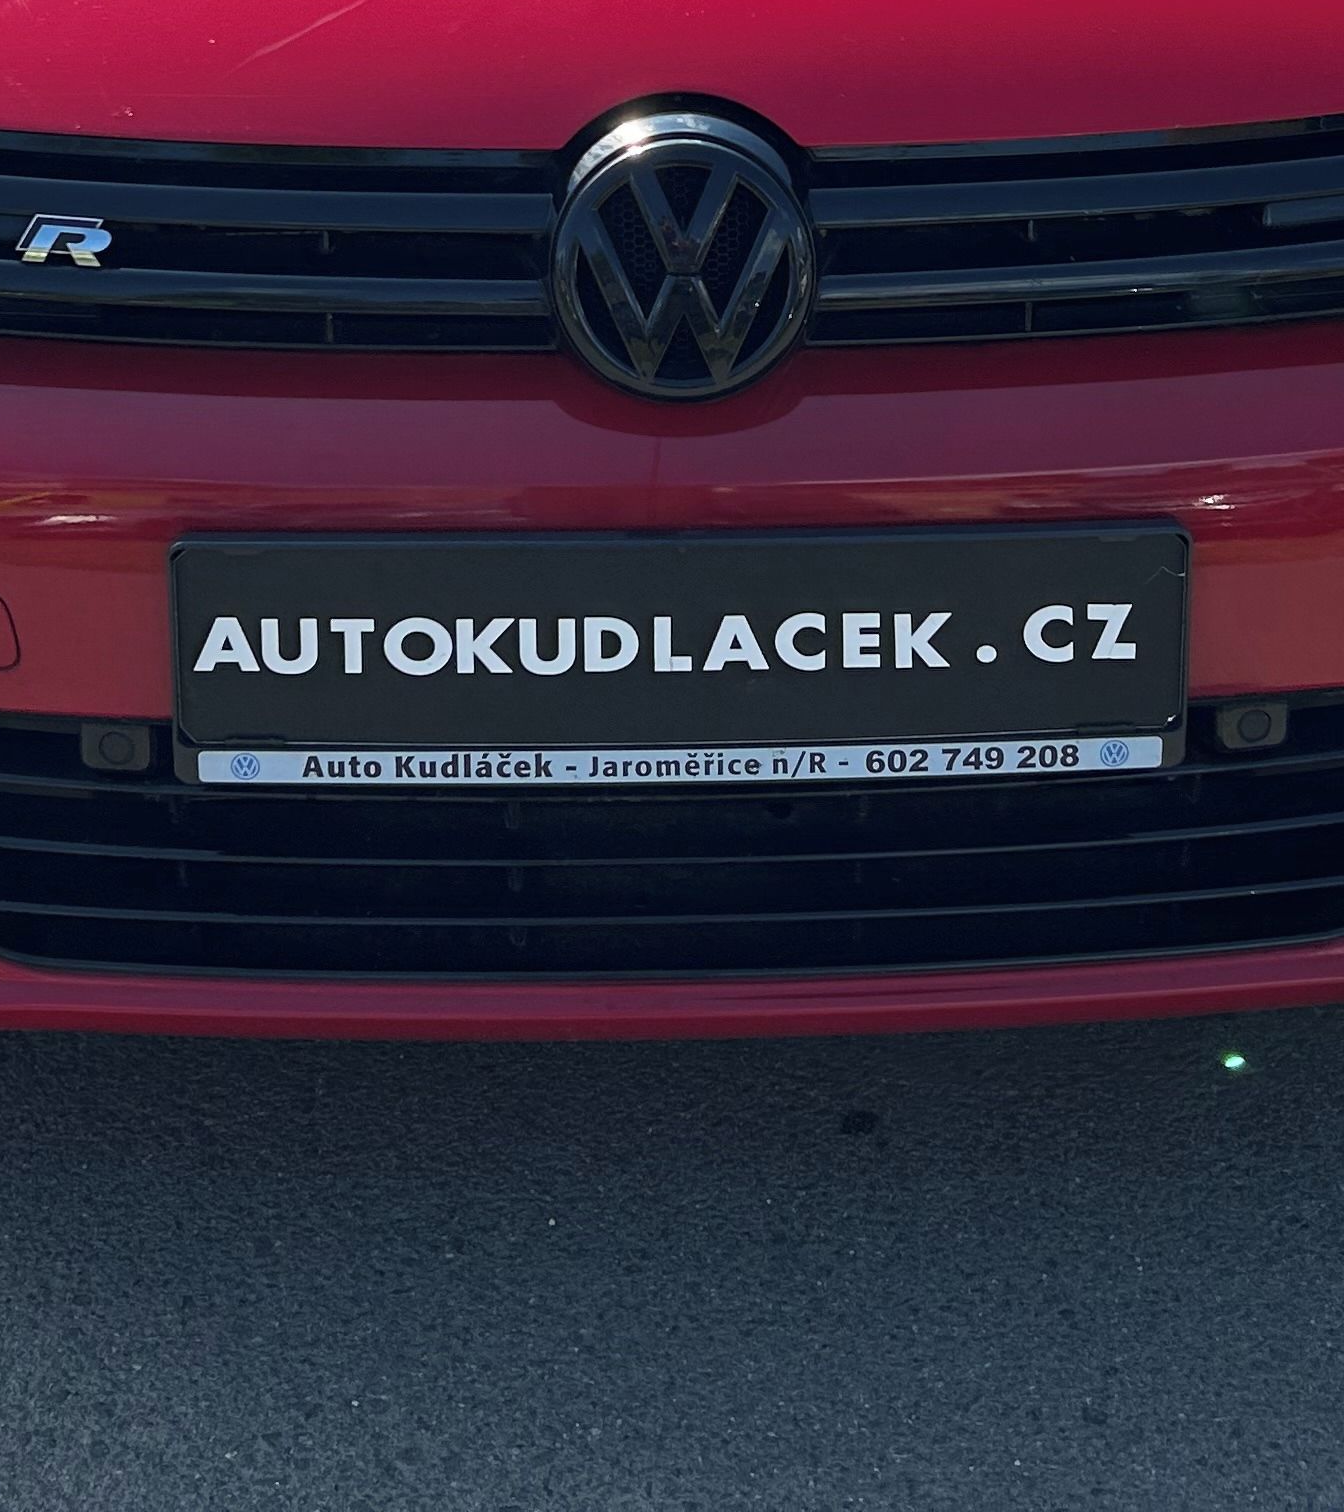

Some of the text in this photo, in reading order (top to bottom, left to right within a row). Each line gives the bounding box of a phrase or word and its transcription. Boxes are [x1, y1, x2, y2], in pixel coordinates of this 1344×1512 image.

[16, 213, 113, 268] R
[302, 755, 382, 778] Auto
[395, 752, 553, 779] Kudláček
[588, 752, 762, 778] Jaroměřice
[772, 750, 827, 778] n/R
[865, 748, 929, 774] 602
[941, 746, 1005, 771] 749
[1016, 744, 1080, 769] 208
